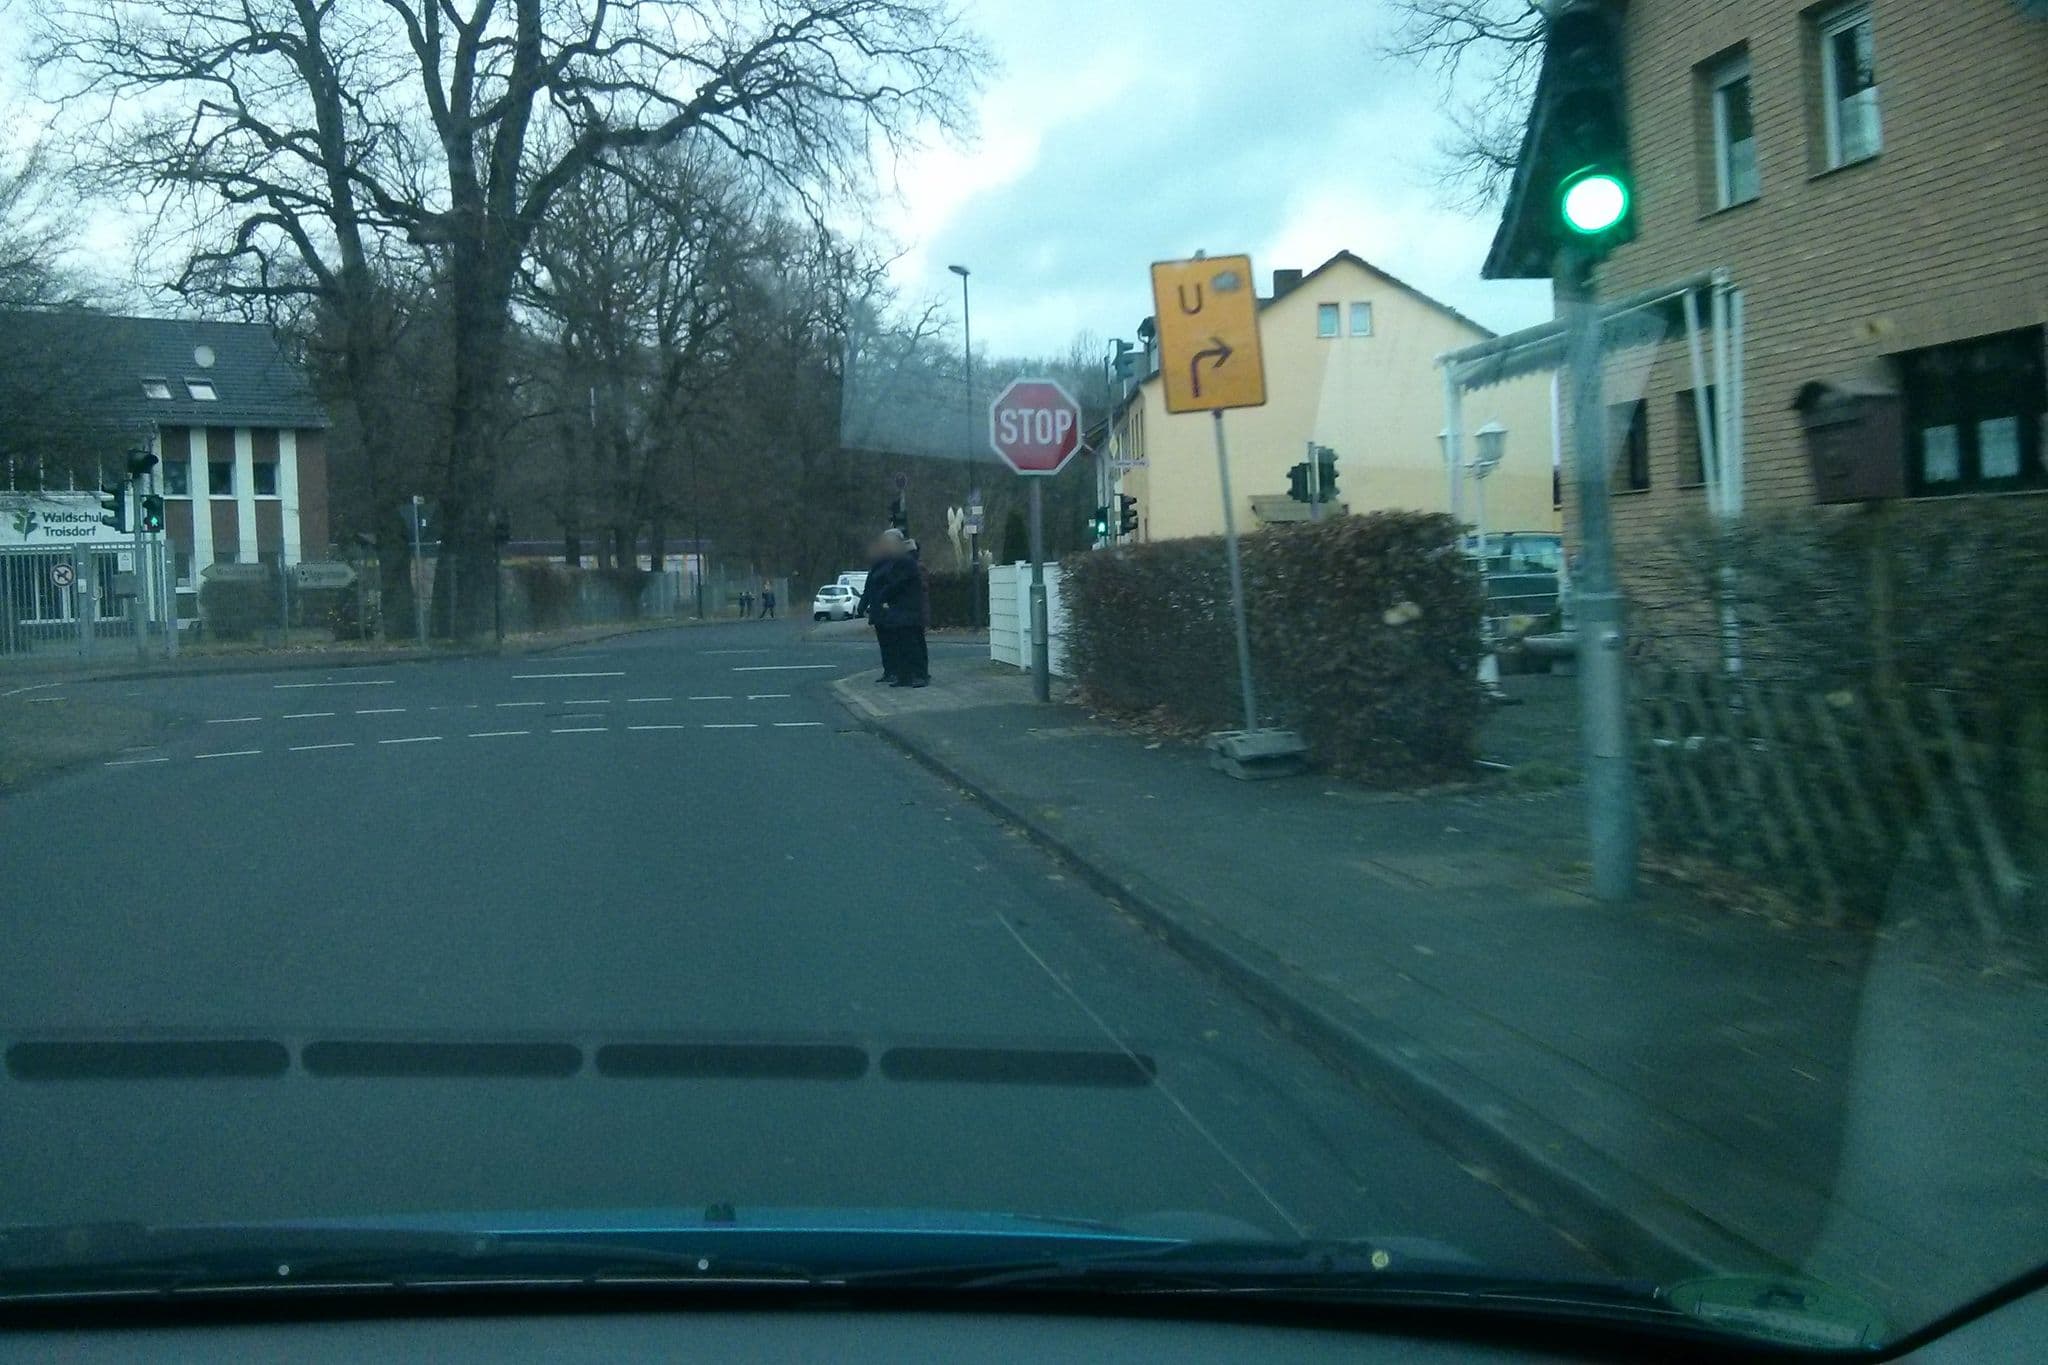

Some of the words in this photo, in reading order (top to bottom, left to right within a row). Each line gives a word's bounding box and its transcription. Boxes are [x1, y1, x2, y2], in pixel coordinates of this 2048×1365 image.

[1178, 284, 1202, 315] U
[1000, 408, 1072, 445] STOP
[44, 525, 97, 537] Troisdorf
